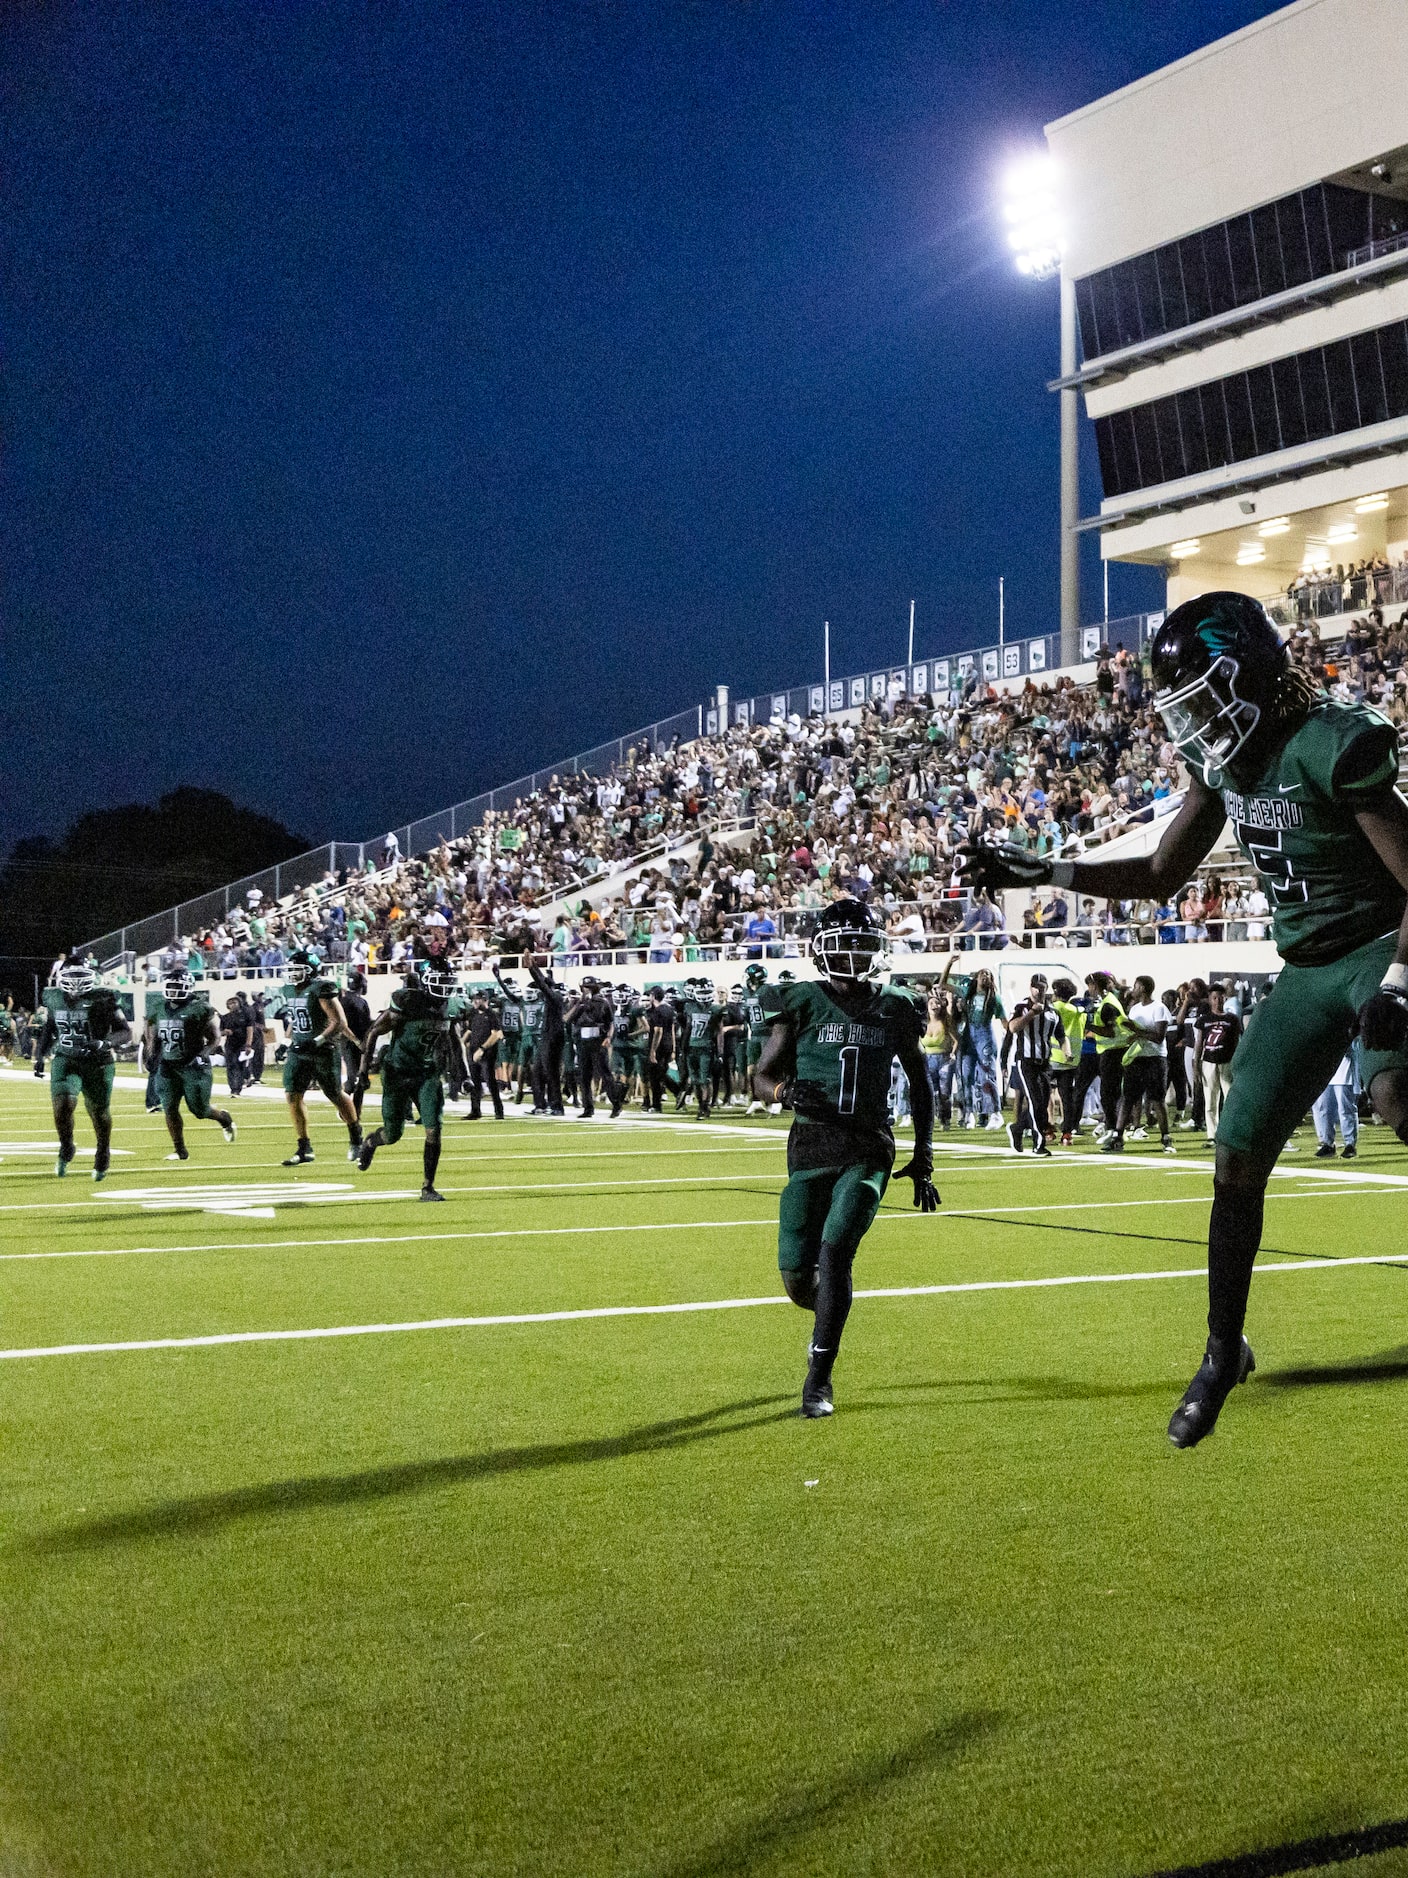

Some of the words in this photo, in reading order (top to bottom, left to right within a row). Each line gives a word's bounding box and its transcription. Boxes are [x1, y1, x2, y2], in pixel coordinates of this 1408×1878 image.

[1006, 653, 1018, 669] 53
[1247, 797, 1304, 830] HERD
[1236, 820, 1308, 904] 5
[816, 1022, 846, 1043] THE
[847, 1023, 886, 1048] HERD
[838, 1045, 860, 1115] 1
